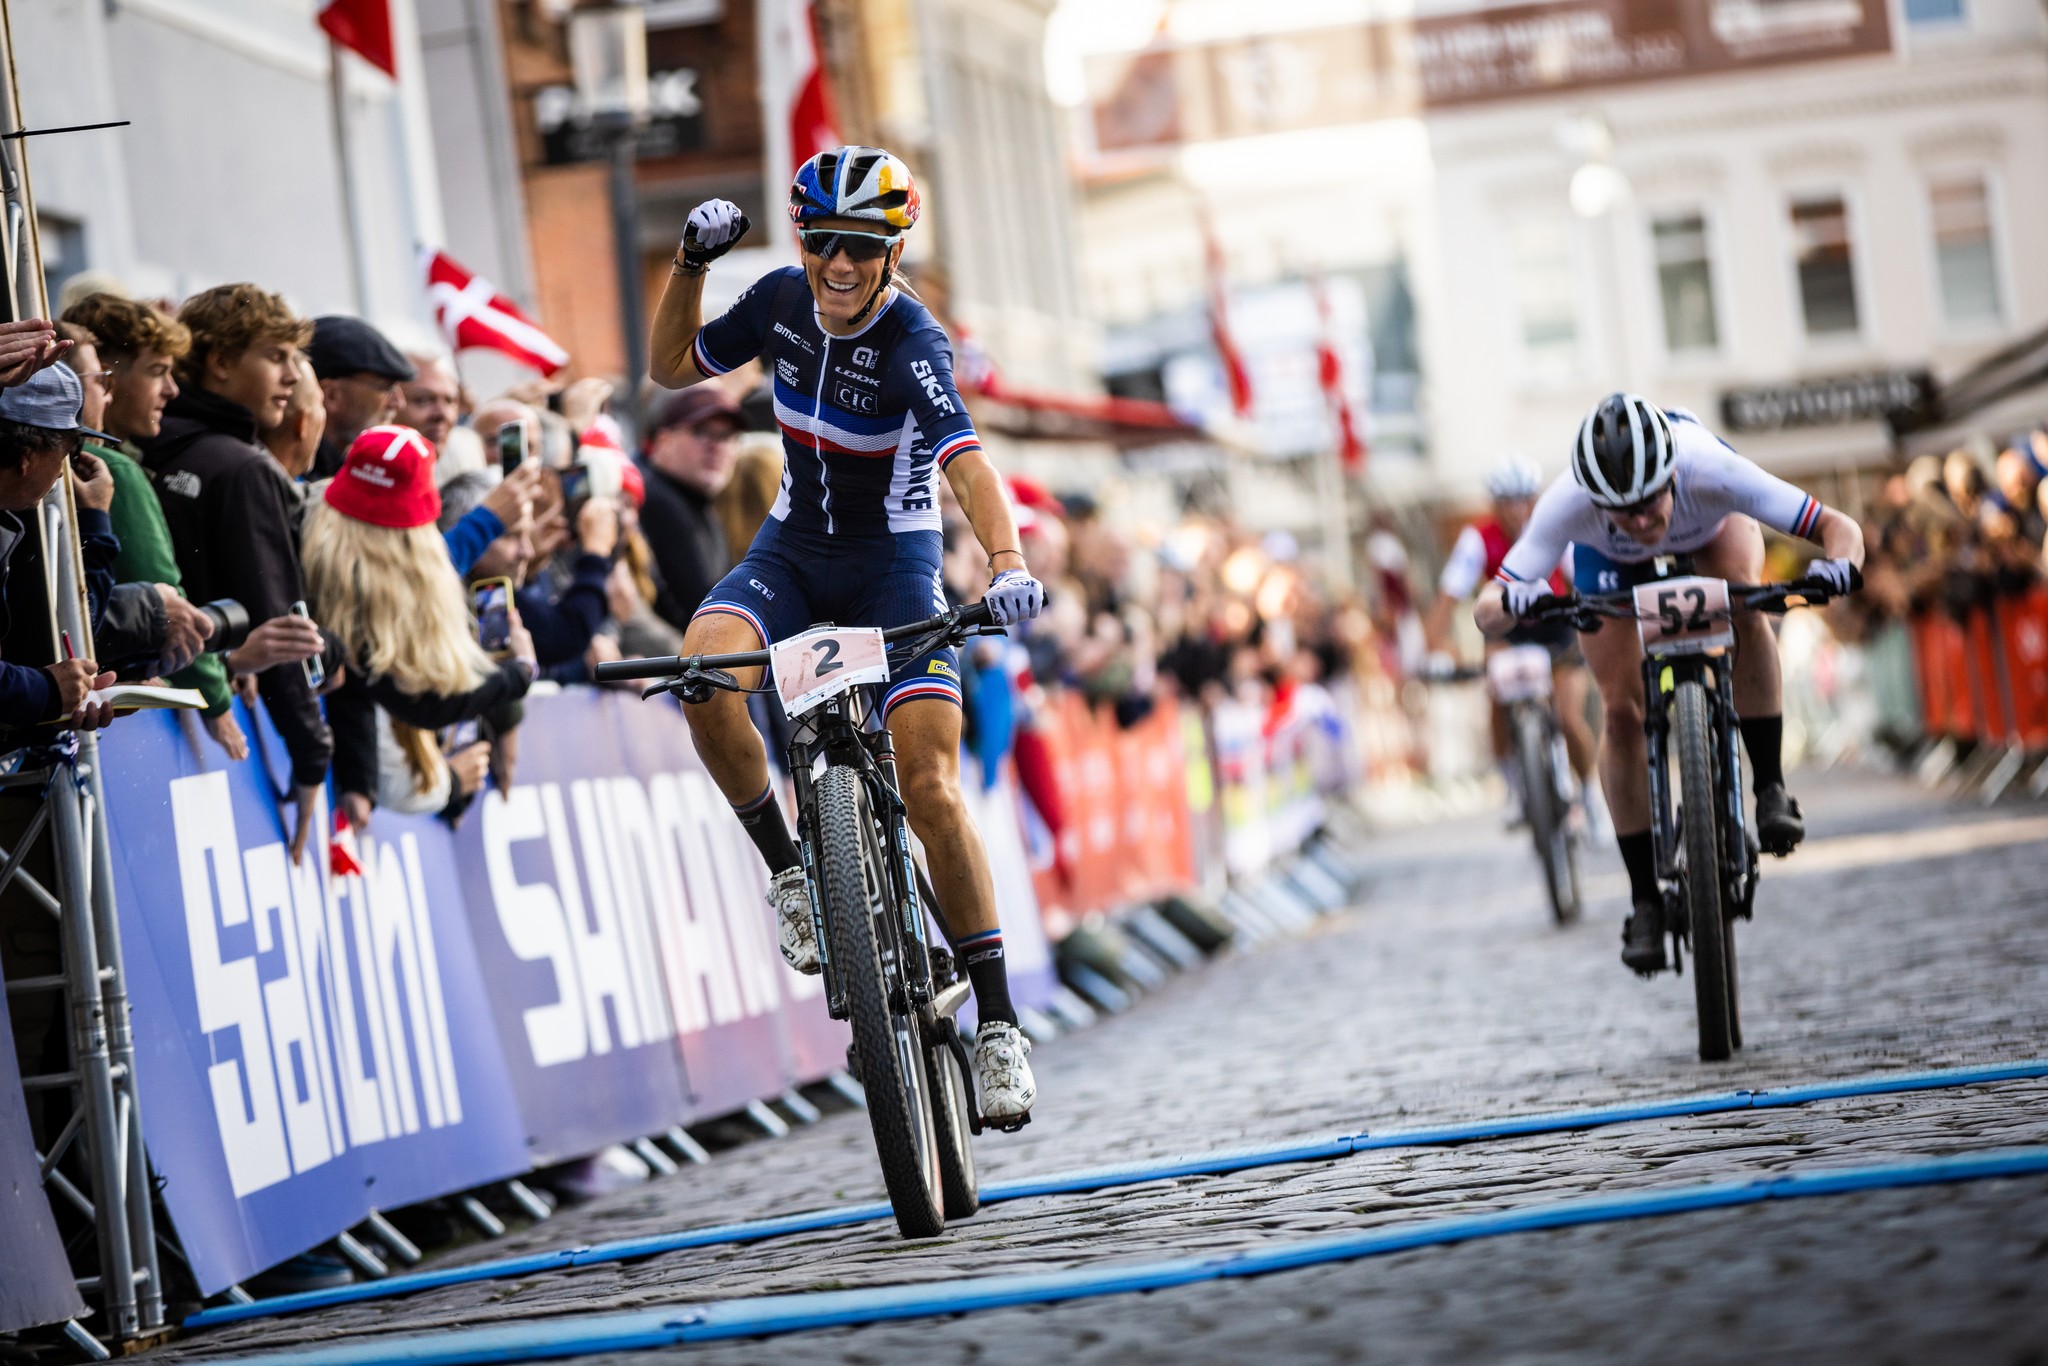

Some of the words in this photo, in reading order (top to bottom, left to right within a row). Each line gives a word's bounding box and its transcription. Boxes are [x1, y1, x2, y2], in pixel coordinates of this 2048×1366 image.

[773, 322, 801, 345] BMC
[777, 363, 793, 378] GOOD
[779, 358, 800, 374] SMART
[834, 366, 881, 388] LOOK
[777, 370, 797, 387] THINGS
[910, 359, 956, 415] SKF
[1658, 587, 1711, 635] 52
[811, 638, 844, 678] 2
